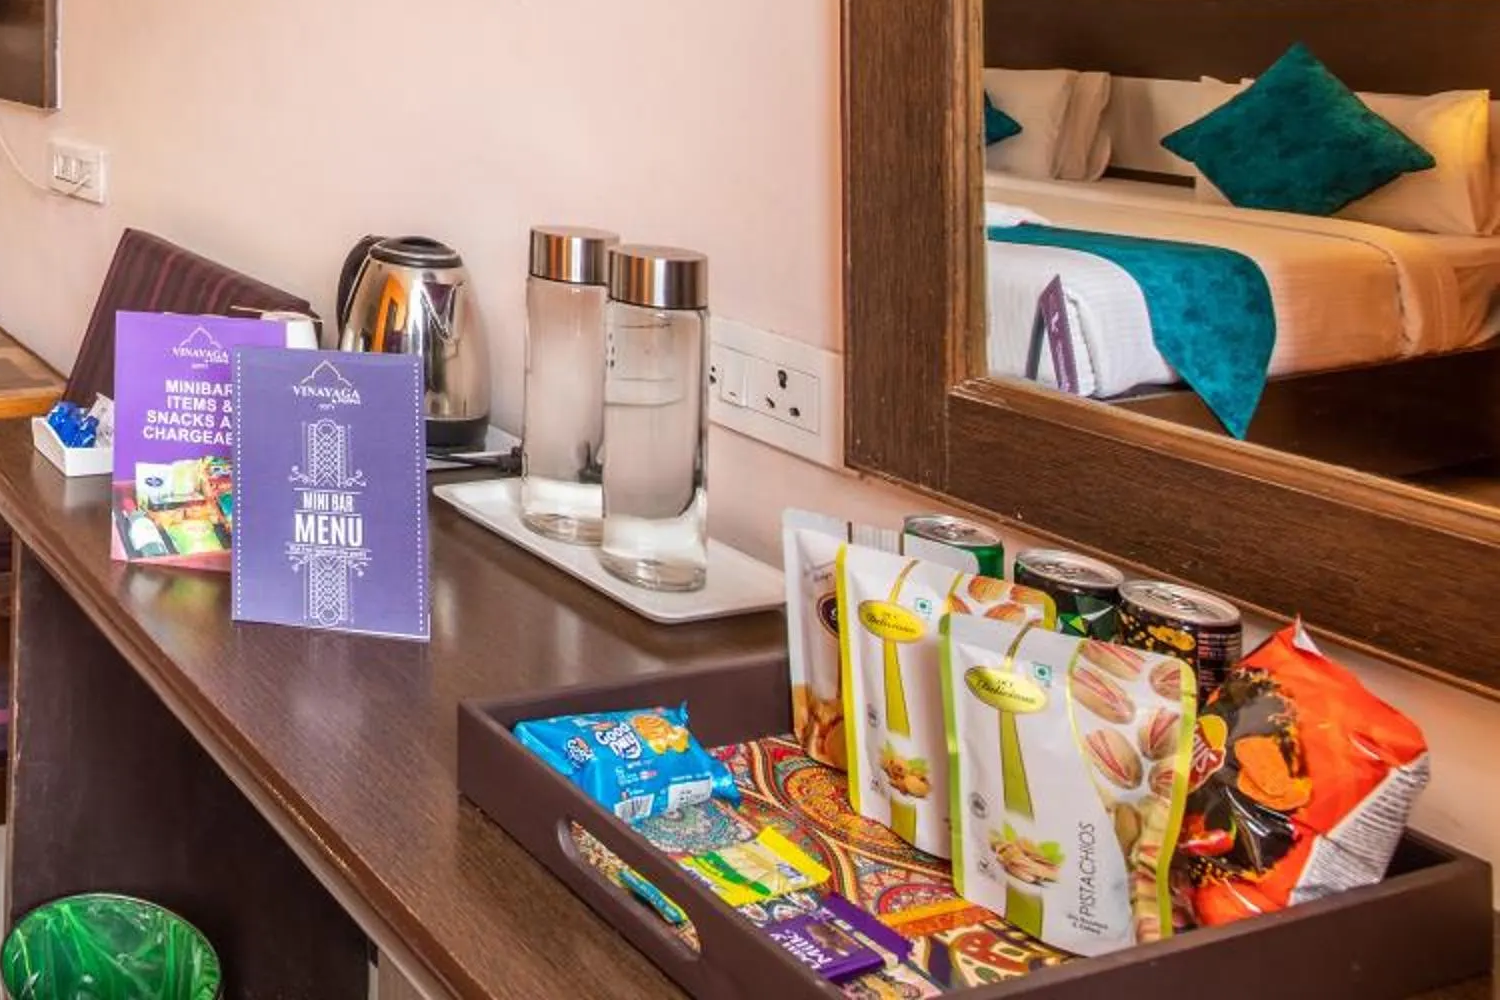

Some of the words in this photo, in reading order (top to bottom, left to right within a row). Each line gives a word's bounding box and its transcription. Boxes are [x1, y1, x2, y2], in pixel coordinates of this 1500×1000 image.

[167, 395, 217, 413] ITEMS
[222, 399, 233, 413] &
[292, 385, 360, 402] VINAYAGA
[147, 409, 215, 429] SNACKS
[303, 491, 329, 511] MINI
[331, 492, 353, 513] BAR
[295, 513, 363, 547] MENU
[1078, 821, 1097, 916] PISTACHIOS
